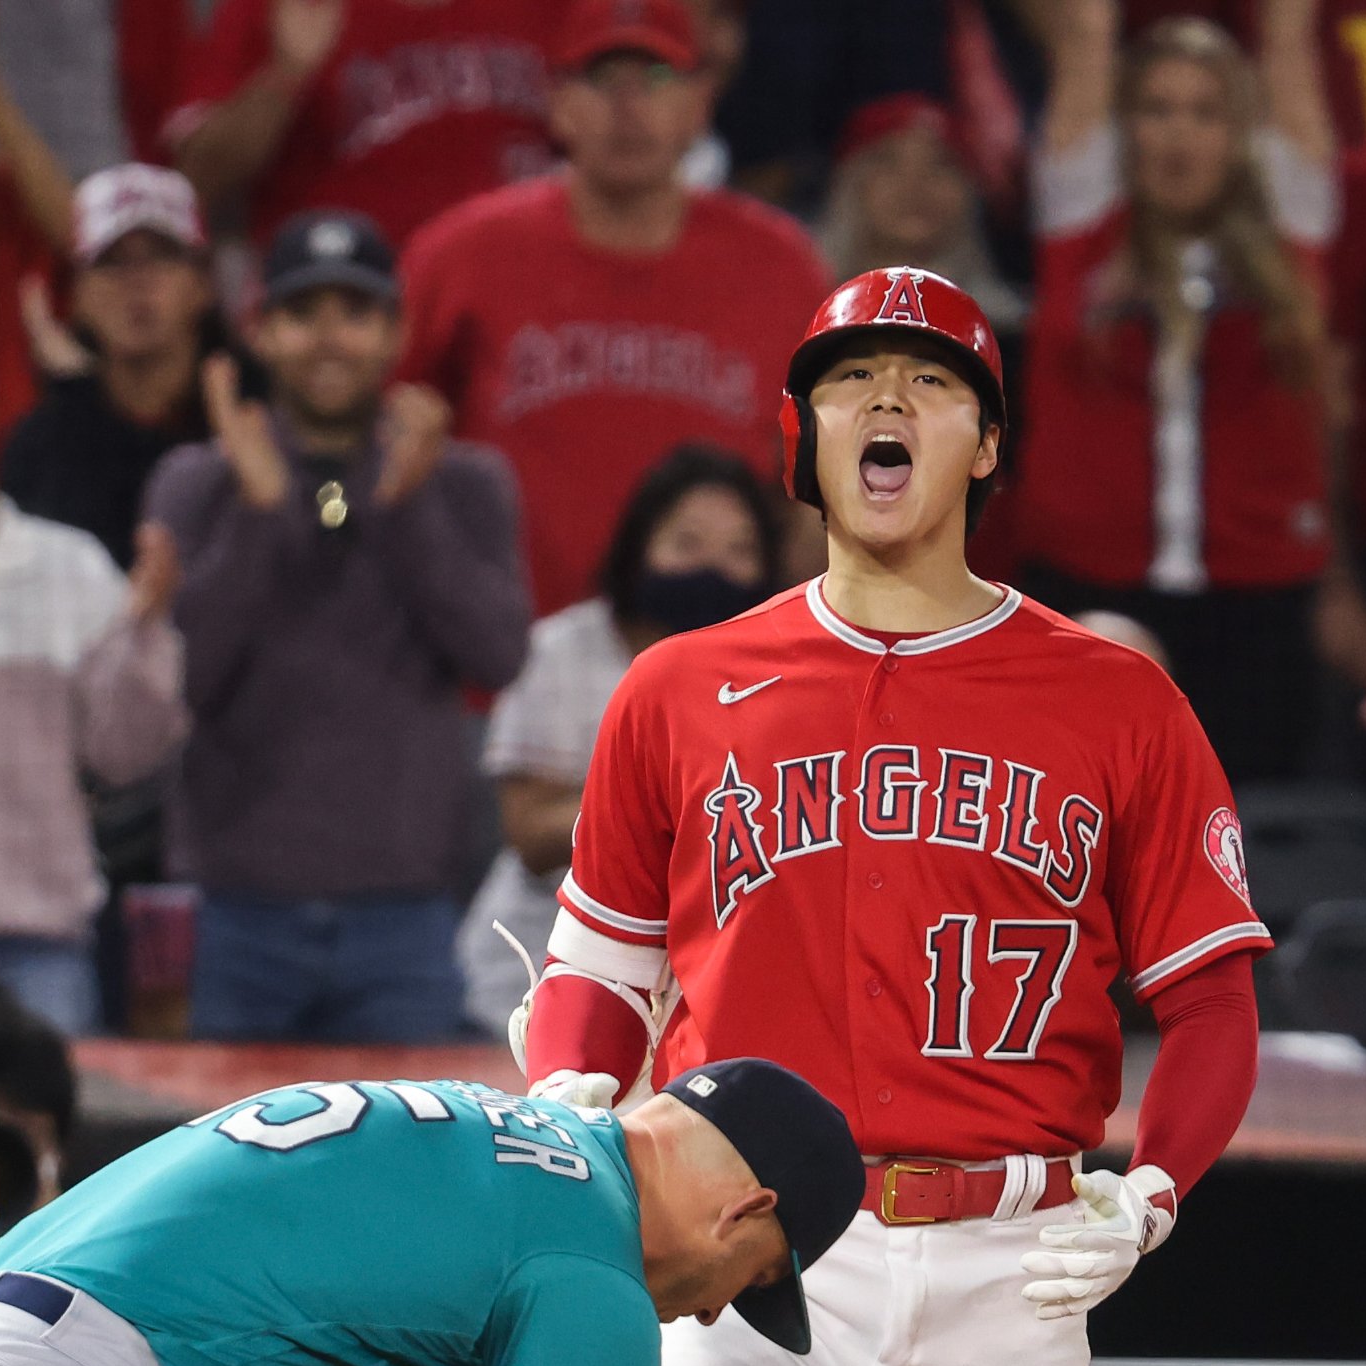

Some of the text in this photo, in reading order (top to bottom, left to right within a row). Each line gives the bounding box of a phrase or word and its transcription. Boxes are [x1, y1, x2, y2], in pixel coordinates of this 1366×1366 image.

[873, 266, 929, 327] A
[704, 745, 1104, 930] ANGELS
[921, 914, 1078, 1060] 17
